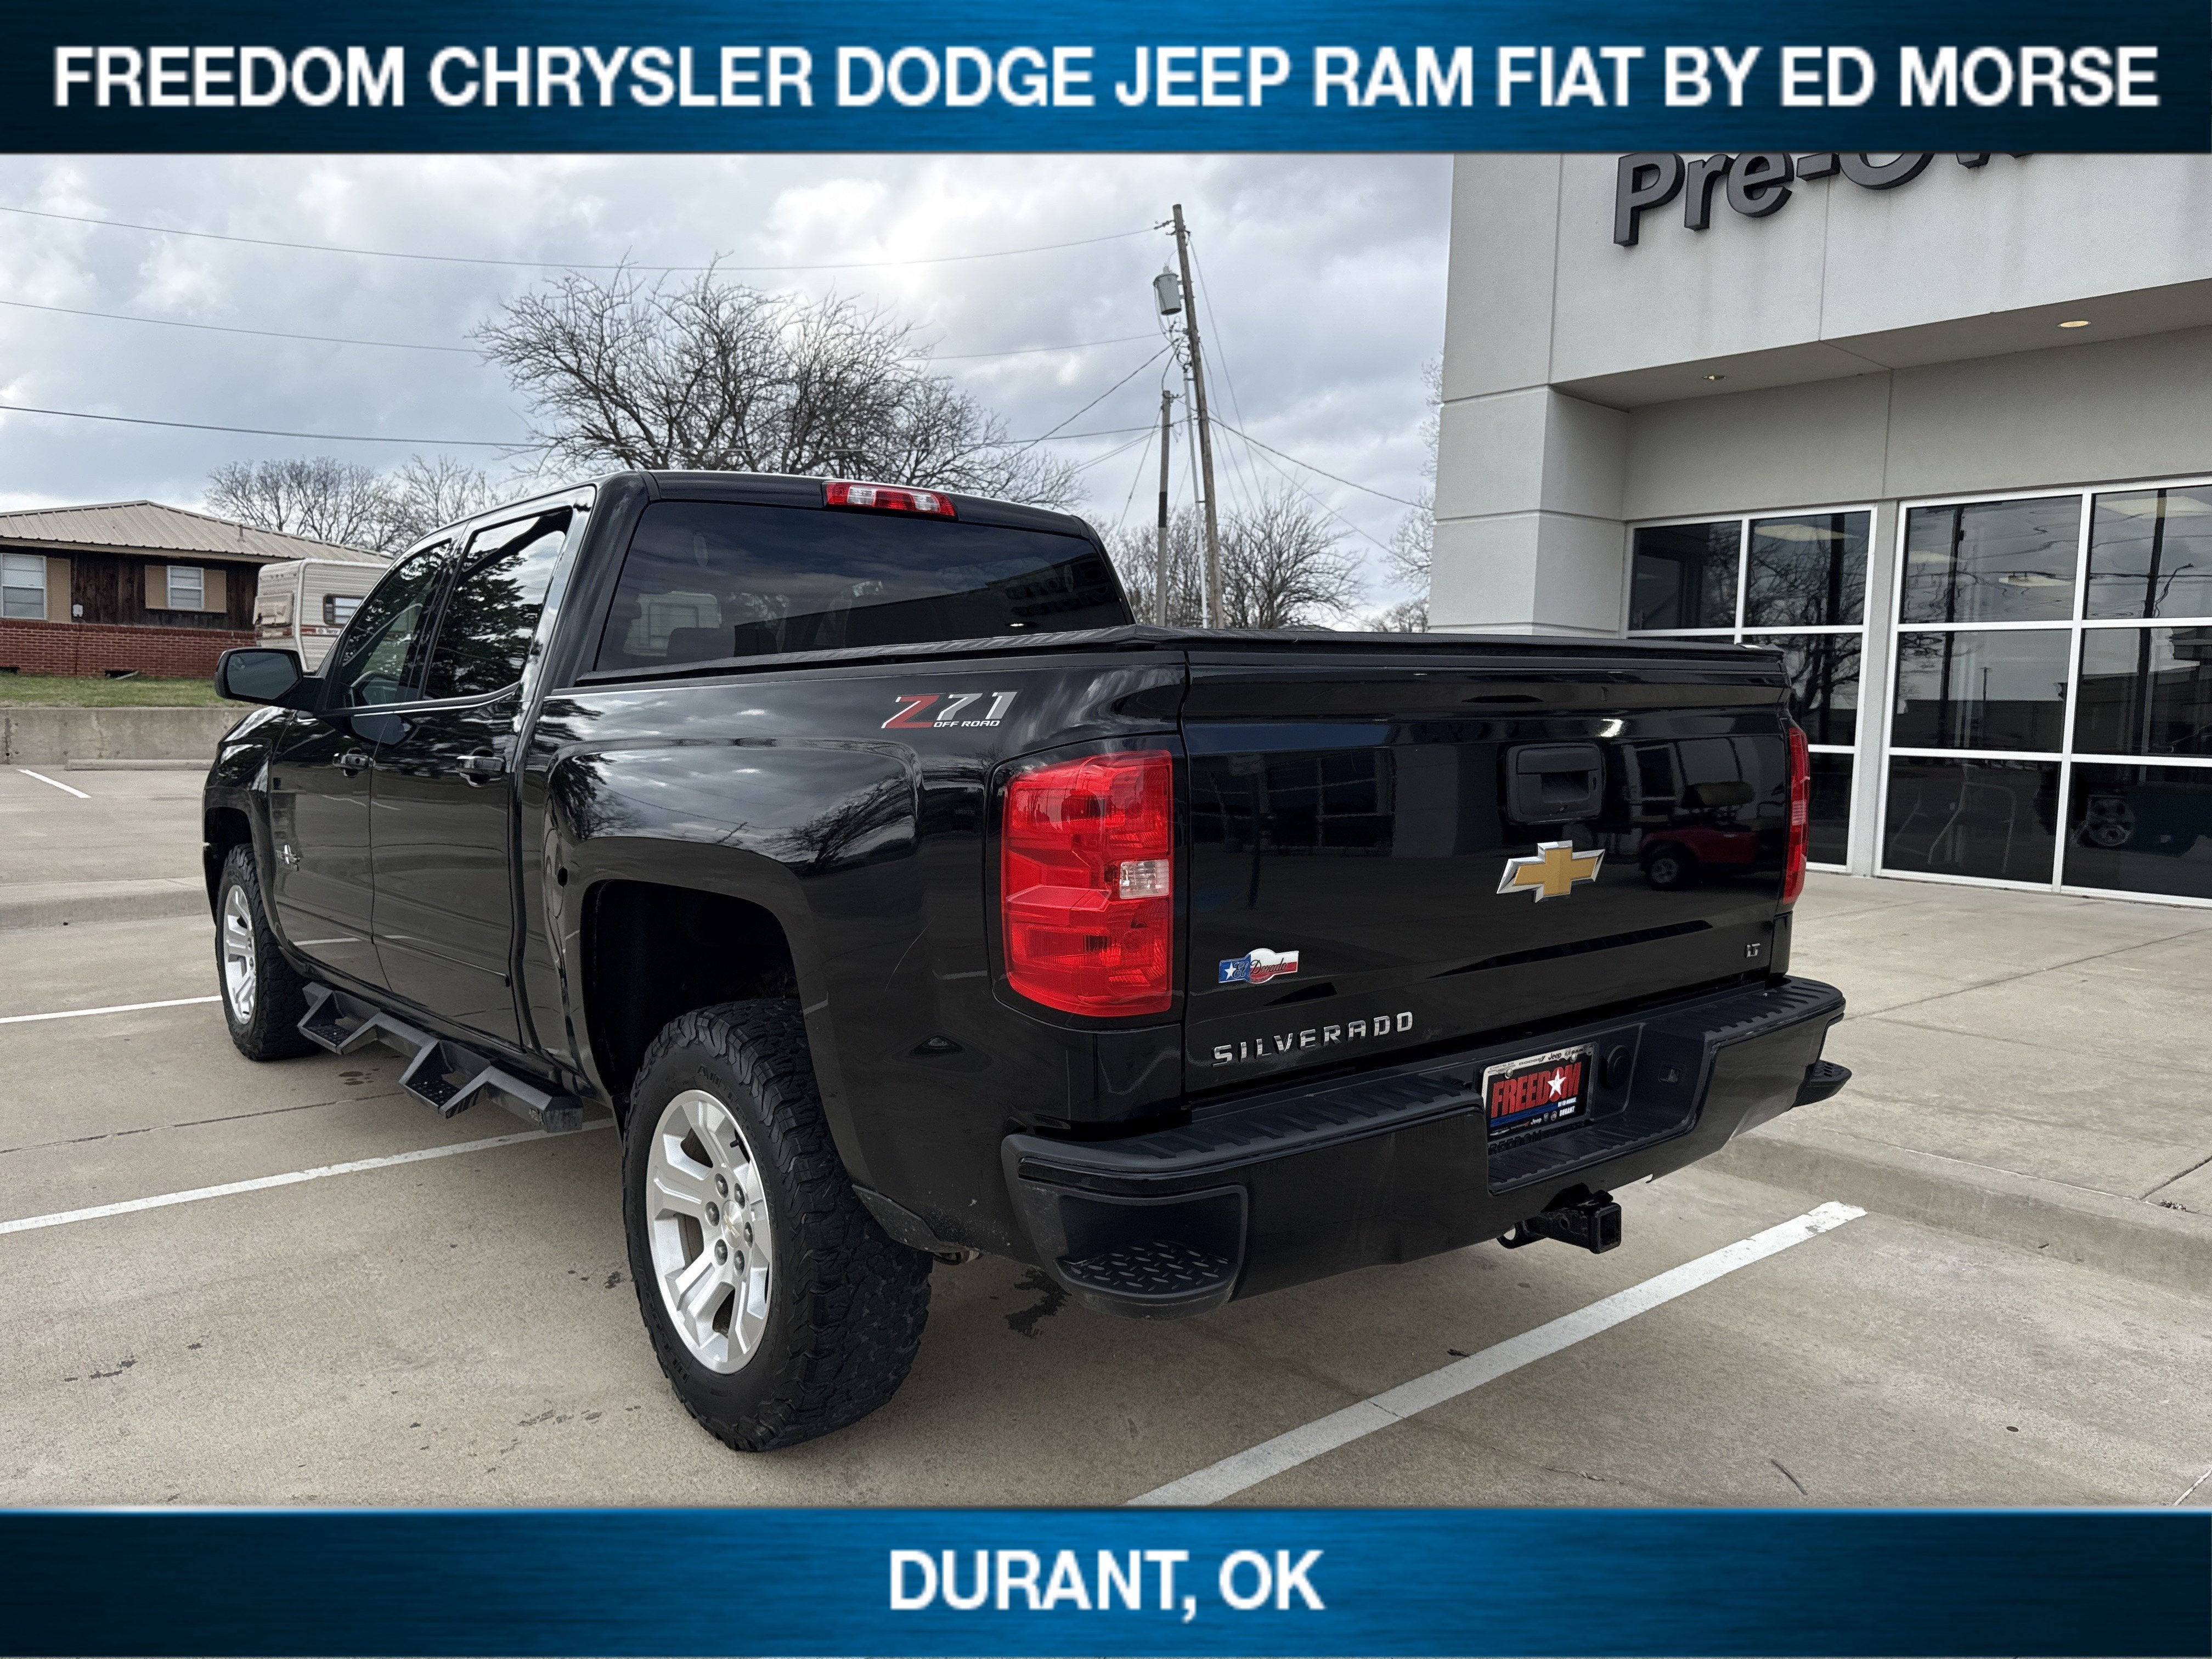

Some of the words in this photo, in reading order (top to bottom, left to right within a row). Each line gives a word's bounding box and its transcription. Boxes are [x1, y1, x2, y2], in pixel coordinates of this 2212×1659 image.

[881, 691, 1018, 729] Z71
[1746, 943, 1760, 958] LT
[1232, 961, 1249, 979] El
[1248, 957, 1287, 977] Dorado
[1211, 1011, 1414, 1069] SILVERADO
[1548, 1052, 1562, 1061] Jeep
[1491, 1062, 1582, 1118] FREEDOM
[1559, 1105, 1576, 1117] DURANT
